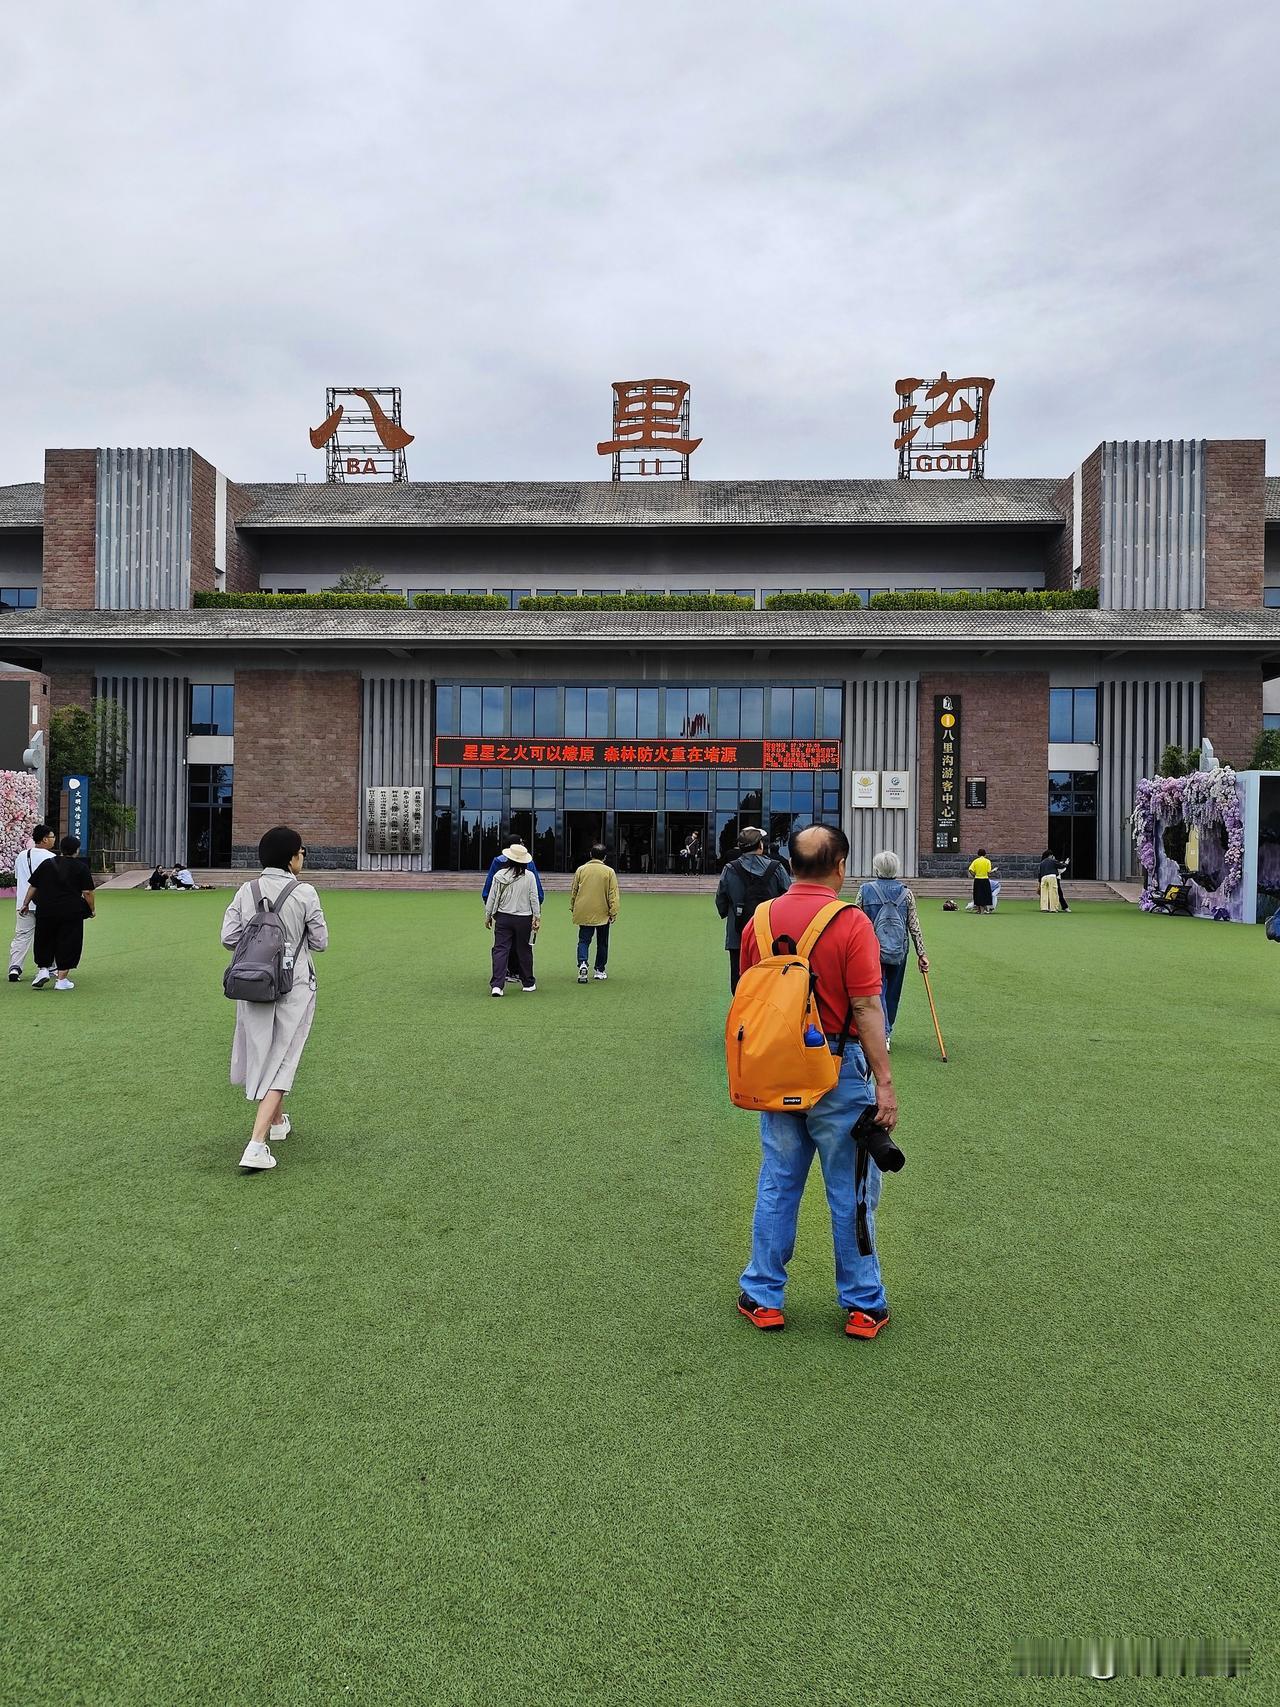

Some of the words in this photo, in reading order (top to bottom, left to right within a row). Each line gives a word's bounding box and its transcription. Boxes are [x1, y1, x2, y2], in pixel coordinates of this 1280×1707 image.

[309, 388, 415, 451] 八
[597, 378, 703, 456] 里
[893, 371, 995, 451] 沟
[346, 457, 378, 475] BA
[640, 458, 661, 475] LI
[916, 453, 973, 472] GOU
[463, 744, 595, 762] 星星之火可以燎原
[604, 745, 737, 763] 森林防火重在堵源
[941, 730, 955, 818] 八里沟游客中心
